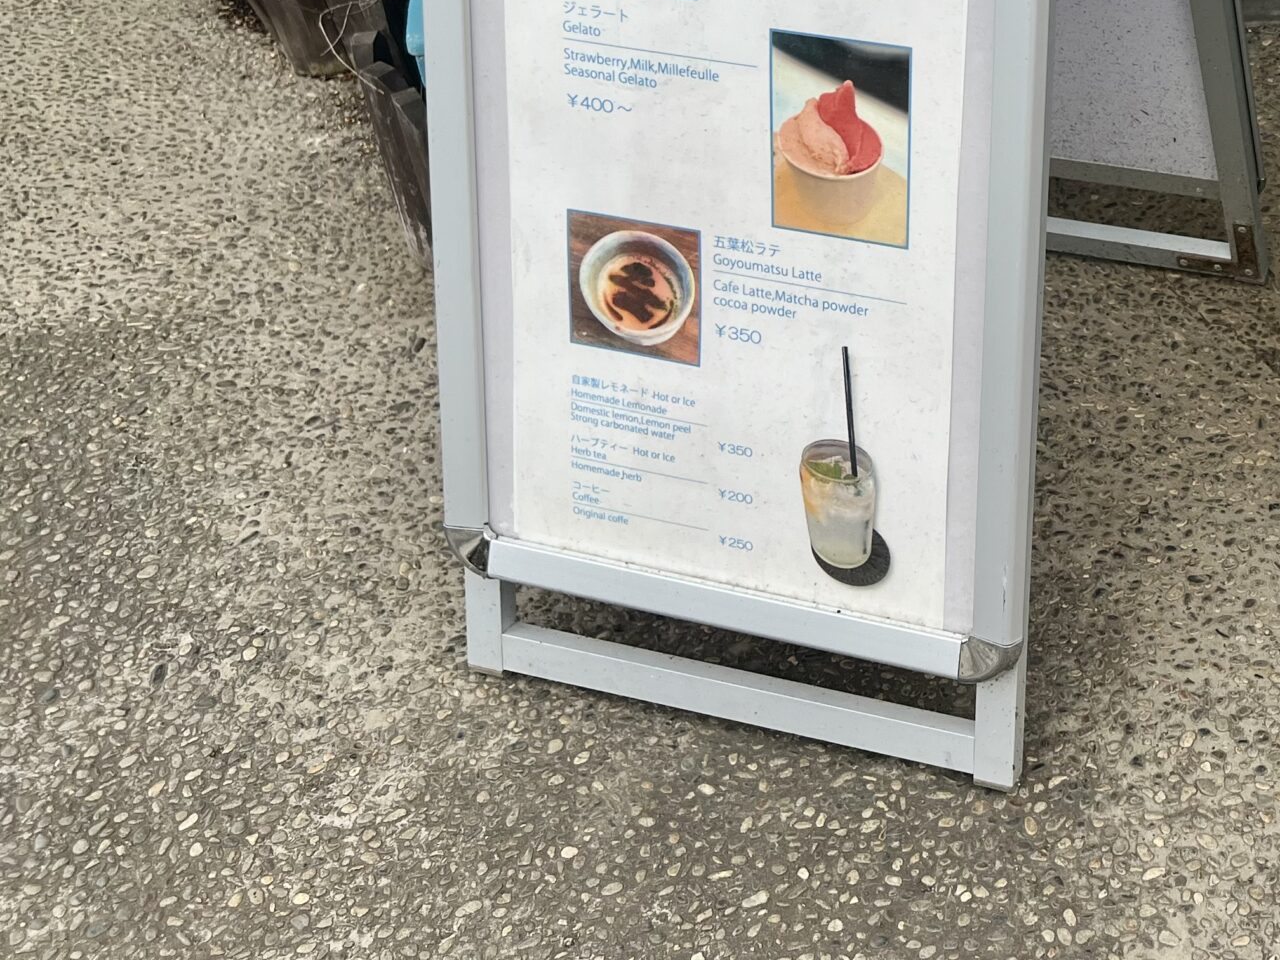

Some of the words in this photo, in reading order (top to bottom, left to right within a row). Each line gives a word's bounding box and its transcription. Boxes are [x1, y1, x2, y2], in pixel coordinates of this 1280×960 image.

[562, 1, 629, 23] ジェラート
[562, 20, 601, 37] Gelato
[564, 64, 615, 83] Seasonal
[618, 71, 657, 89] Gelato
[713, 235, 781, 257] 五葉松ラテ
[713, 253, 789, 277] Goyoumatsu
[791, 267, 822, 283] Latte
[713, 279, 739, 294] Cafe
[822, 299, 869, 317] powder
[713, 296, 748, 311] cocoa
[751, 303, 797, 319] powder
[714, 323, 762, 344] ¥350
[571, 389, 620, 406] Homemade
[622, 399, 668, 415] Lemonade
[653, 391, 669, 403] Hot
[671, 395, 681, 405] or
[683, 396, 696, 407] Ice
[570, 402, 610, 418] Domestic
[672, 424, 691, 435] peel
[570, 412, 599, 427] Strong
[600, 418, 649, 435] carbonated
[650, 429, 676, 440] water
[571, 446, 592, 457] Herb
[593, 450, 607, 460] tea
[632, 446, 649, 457] Hot
[650, 451, 661, 460] or
[662, 452, 676, 463] Ice
[717, 441, 753, 458] ¥350
[571, 461, 621, 477] Homemade
[573, 481, 610, 494] コーヒー
[572, 491, 600, 505] Coffee
[718, 488, 753, 505] ¥200
[572, 506, 605, 521] Original
[719, 535, 754, 552] ¥250
